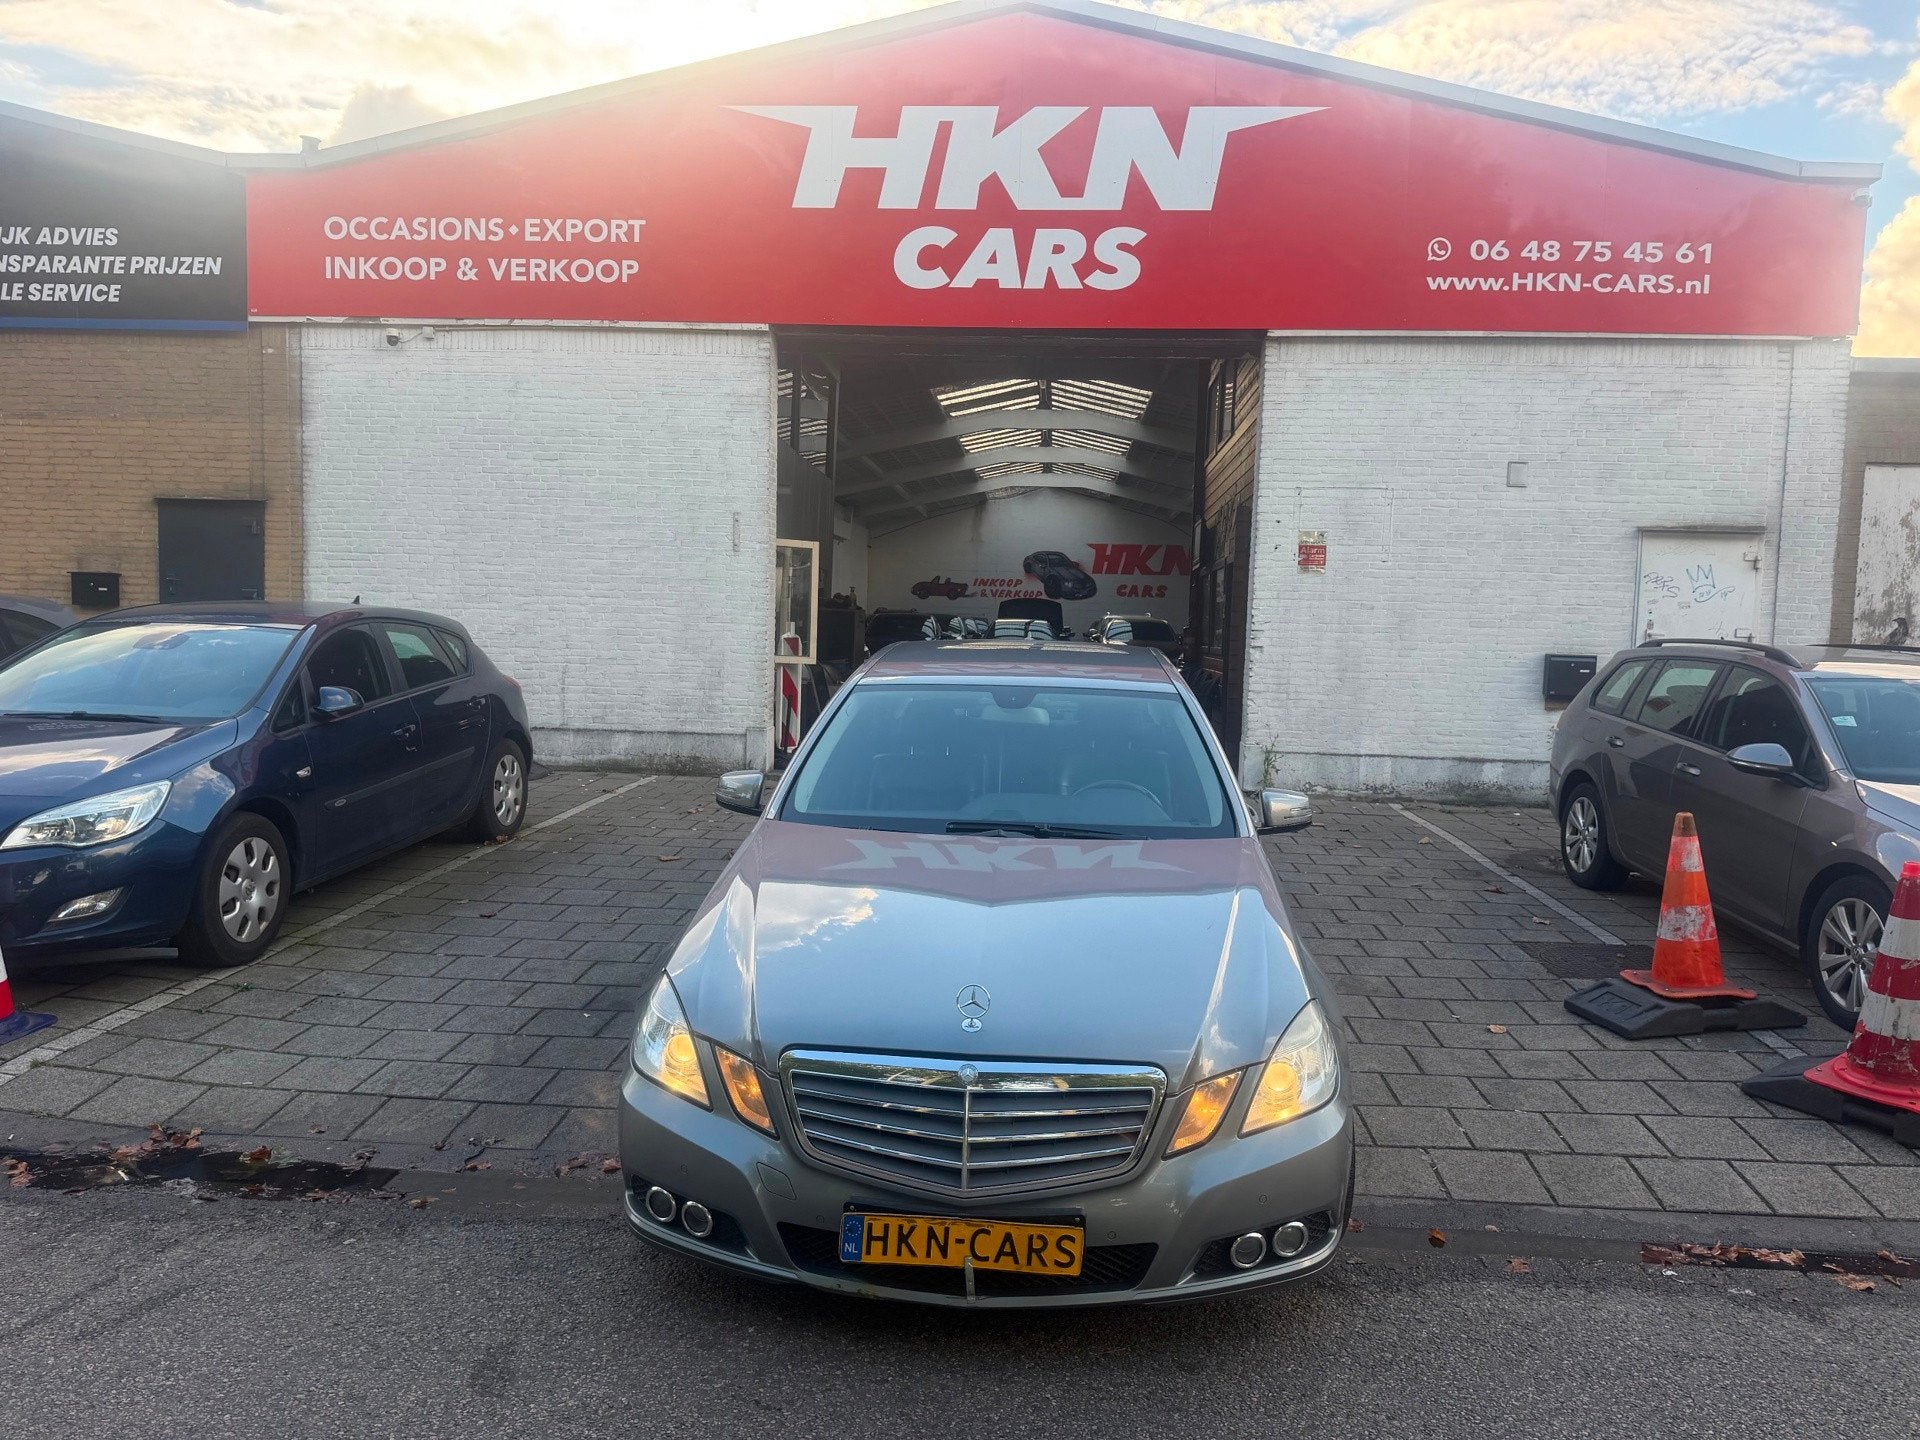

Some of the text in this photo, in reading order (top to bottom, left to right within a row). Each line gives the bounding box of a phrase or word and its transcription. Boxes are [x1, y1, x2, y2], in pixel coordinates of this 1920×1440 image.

[724, 105, 1330, 211] HKN
[0, 227, 119, 246] JK ADVIES
[323, 216, 646, 243] OCCASIONS EXPORT
[893, 226, 1147, 290] CARS
[1470, 239, 1712, 264] 06 48 75 45 61
[129, 256, 222, 275] PRIJZEN
[324, 256, 639, 283] INKOOP & VERKOOP
[0, 282, 121, 302] LE SERVICE
[1426, 272, 1711, 294] www.HKN-CARS.nl
[1087, 543, 1191, 576] HKN
[973, 578, 1023, 588] INKOOP
[980, 588, 1043, 598] & VERKOOP
[1116, 584, 1168, 598] CARS
[844, 1242, 858, 1253] NL
[865, 1222, 1077, 1270] HKN-CARS
